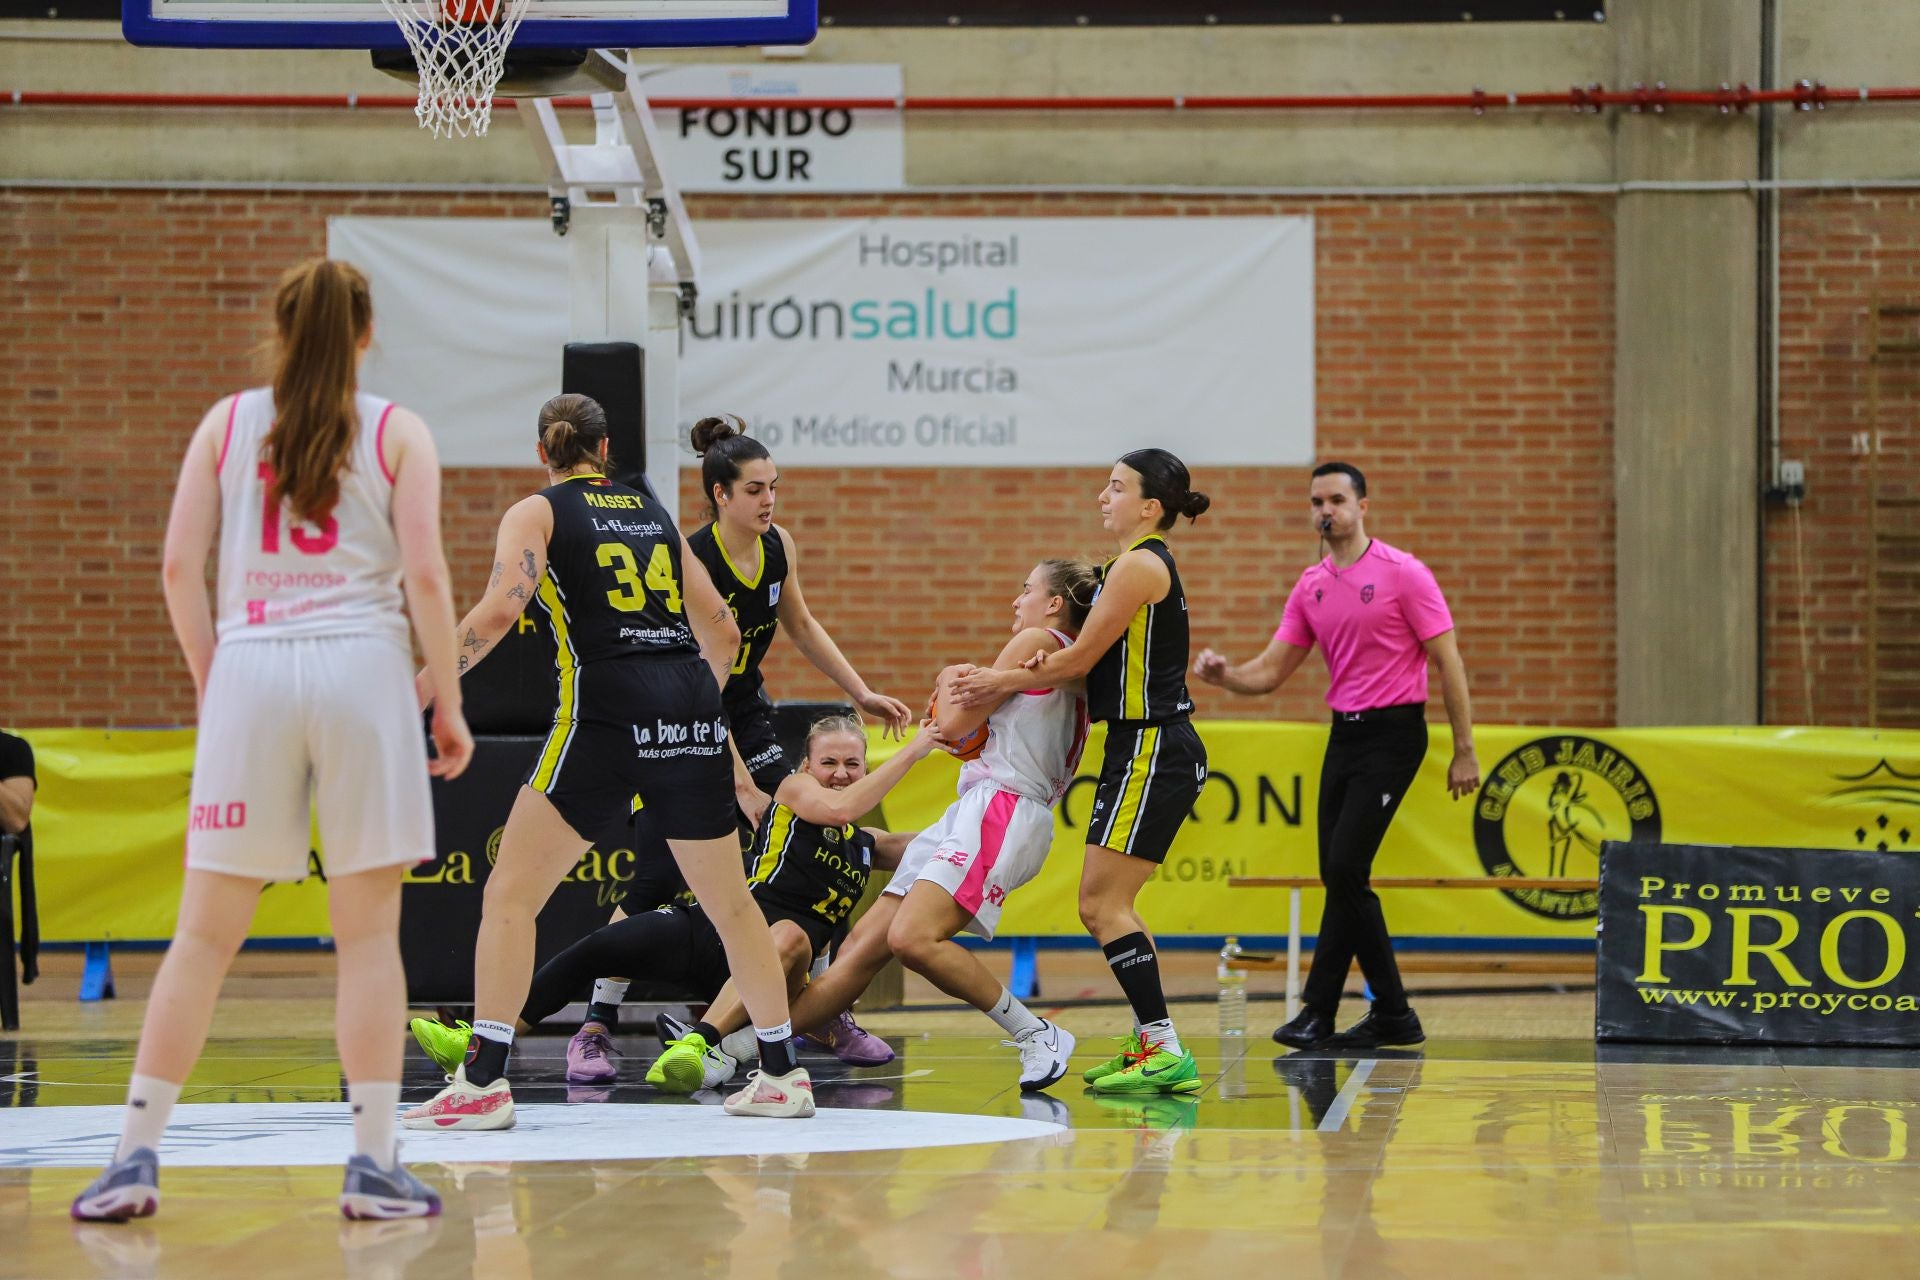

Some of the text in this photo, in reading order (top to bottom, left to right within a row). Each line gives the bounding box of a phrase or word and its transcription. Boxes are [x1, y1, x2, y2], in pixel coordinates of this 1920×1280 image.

[680, 107, 852, 138] FONDO
[722, 149, 811, 180] SUR
[859, 235, 1017, 272] Hospital
[680, 287, 1018, 350] uirónsalud
[887, 361, 1017, 392] Murcia
[792, 415, 904, 448] Médico
[914, 415, 1017, 447] Oficial
[583, 492, 644, 509] MASSEY
[591, 517, 663, 532] La Hacienda
[595, 542, 683, 613] 34
[620, 626, 677, 638] Alcantarilla
[633, 724, 651, 745] la
[657, 719, 687, 744] boca
[693, 721, 711, 742] te
[638, 748, 660, 758] MÁS
[1479, 738, 1655, 822] CLUB JAIRIS
[1638, 876, 1890, 904] Promueve
[1635, 903, 1920, 989] PRO
[474, 1022, 511, 1035] PALDING
